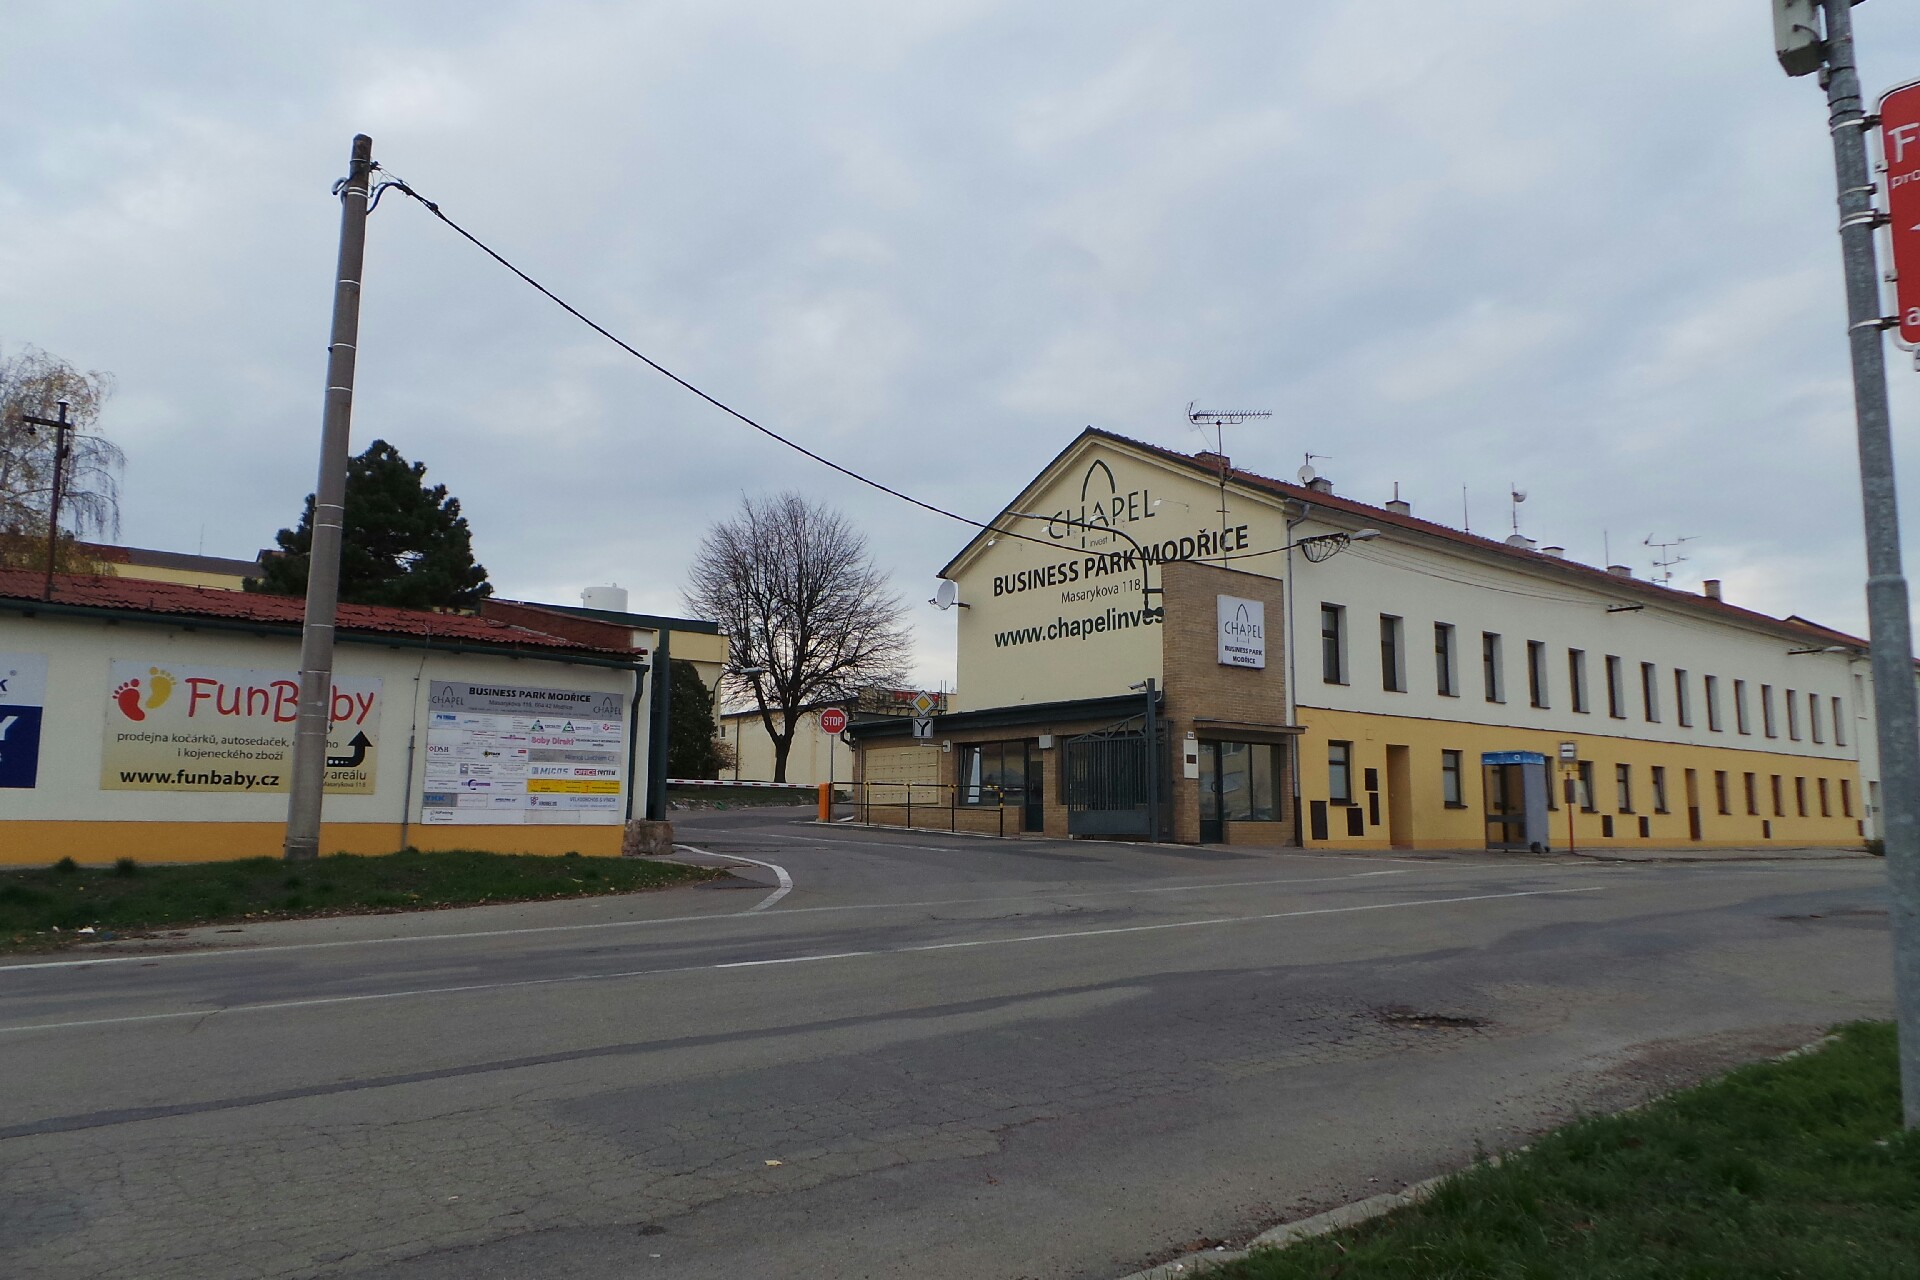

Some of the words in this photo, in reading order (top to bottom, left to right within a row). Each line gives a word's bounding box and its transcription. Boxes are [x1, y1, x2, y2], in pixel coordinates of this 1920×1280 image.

[1049, 489, 1156, 540] CHAPEL
[993, 560, 1079, 597] BUSINESS
[1084, 549, 1137, 580] PARK
[1142, 524, 1249, 566] MODŘICE
[1061, 583, 1119, 604] Masarykova
[1122, 578, 1141, 593] 118
[1224, 621, 1263, 639] CHAPEL
[1224, 645, 1249, 654] BUSINESS
[1249, 648, 1263, 656] PARK
[185, 677, 375, 726] FunBby
[431, 695, 464, 706] CHAPEL
[468, 687, 517, 698] BUSINESS
[518, 690, 546, 700] PARK
[547, 692, 592, 702] MODŘICE
[593, 705, 621, 716] CHAPEL
[823, 716, 843, 726] STOP
[117, 732, 169, 744] prodejna
[171, 732, 219, 745] kočárků,
[221, 736, 290, 748] autosedaček,
[177, 747, 182, 757] i
[183, 747, 253, 760] kojeneckého
[255, 750, 284, 761] zboží
[119, 769, 280, 789] www.funbaby.cz
[330, 769, 367, 781] areálu
